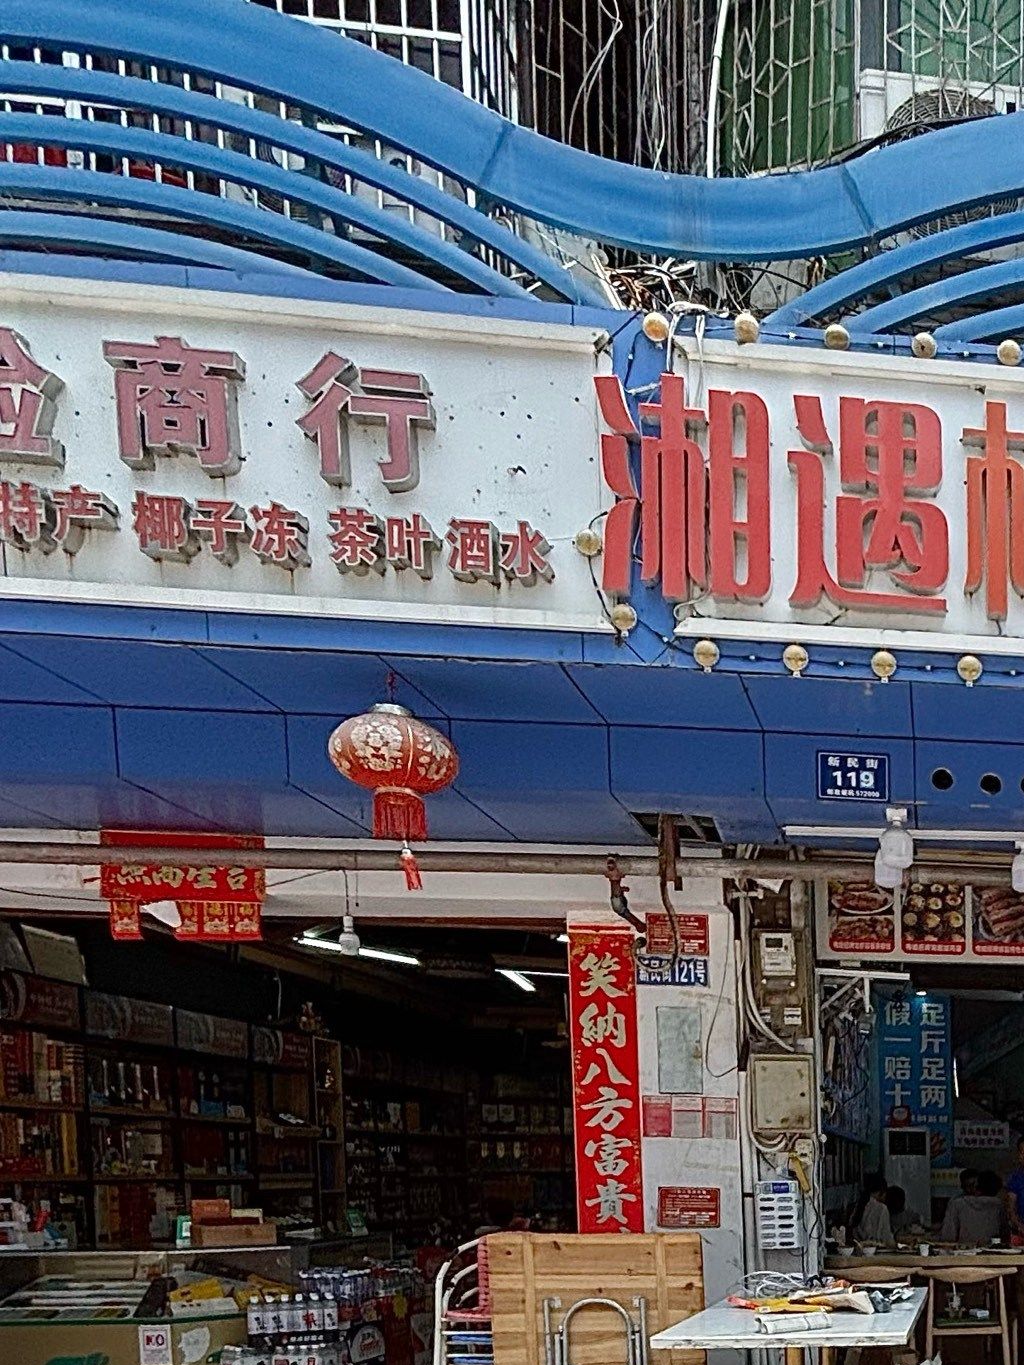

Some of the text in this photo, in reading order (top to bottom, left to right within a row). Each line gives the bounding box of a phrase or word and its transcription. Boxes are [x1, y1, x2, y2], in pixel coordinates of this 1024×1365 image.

[133, 490, 304, 563] 椰子冻
[832, 770, 875, 788] 119
[578, 951, 638, 1235] 笑納八方富貴
[883, 1000, 912, 1107] 假一赔十
[919, 1002, 947, 1108] 足斤足两
